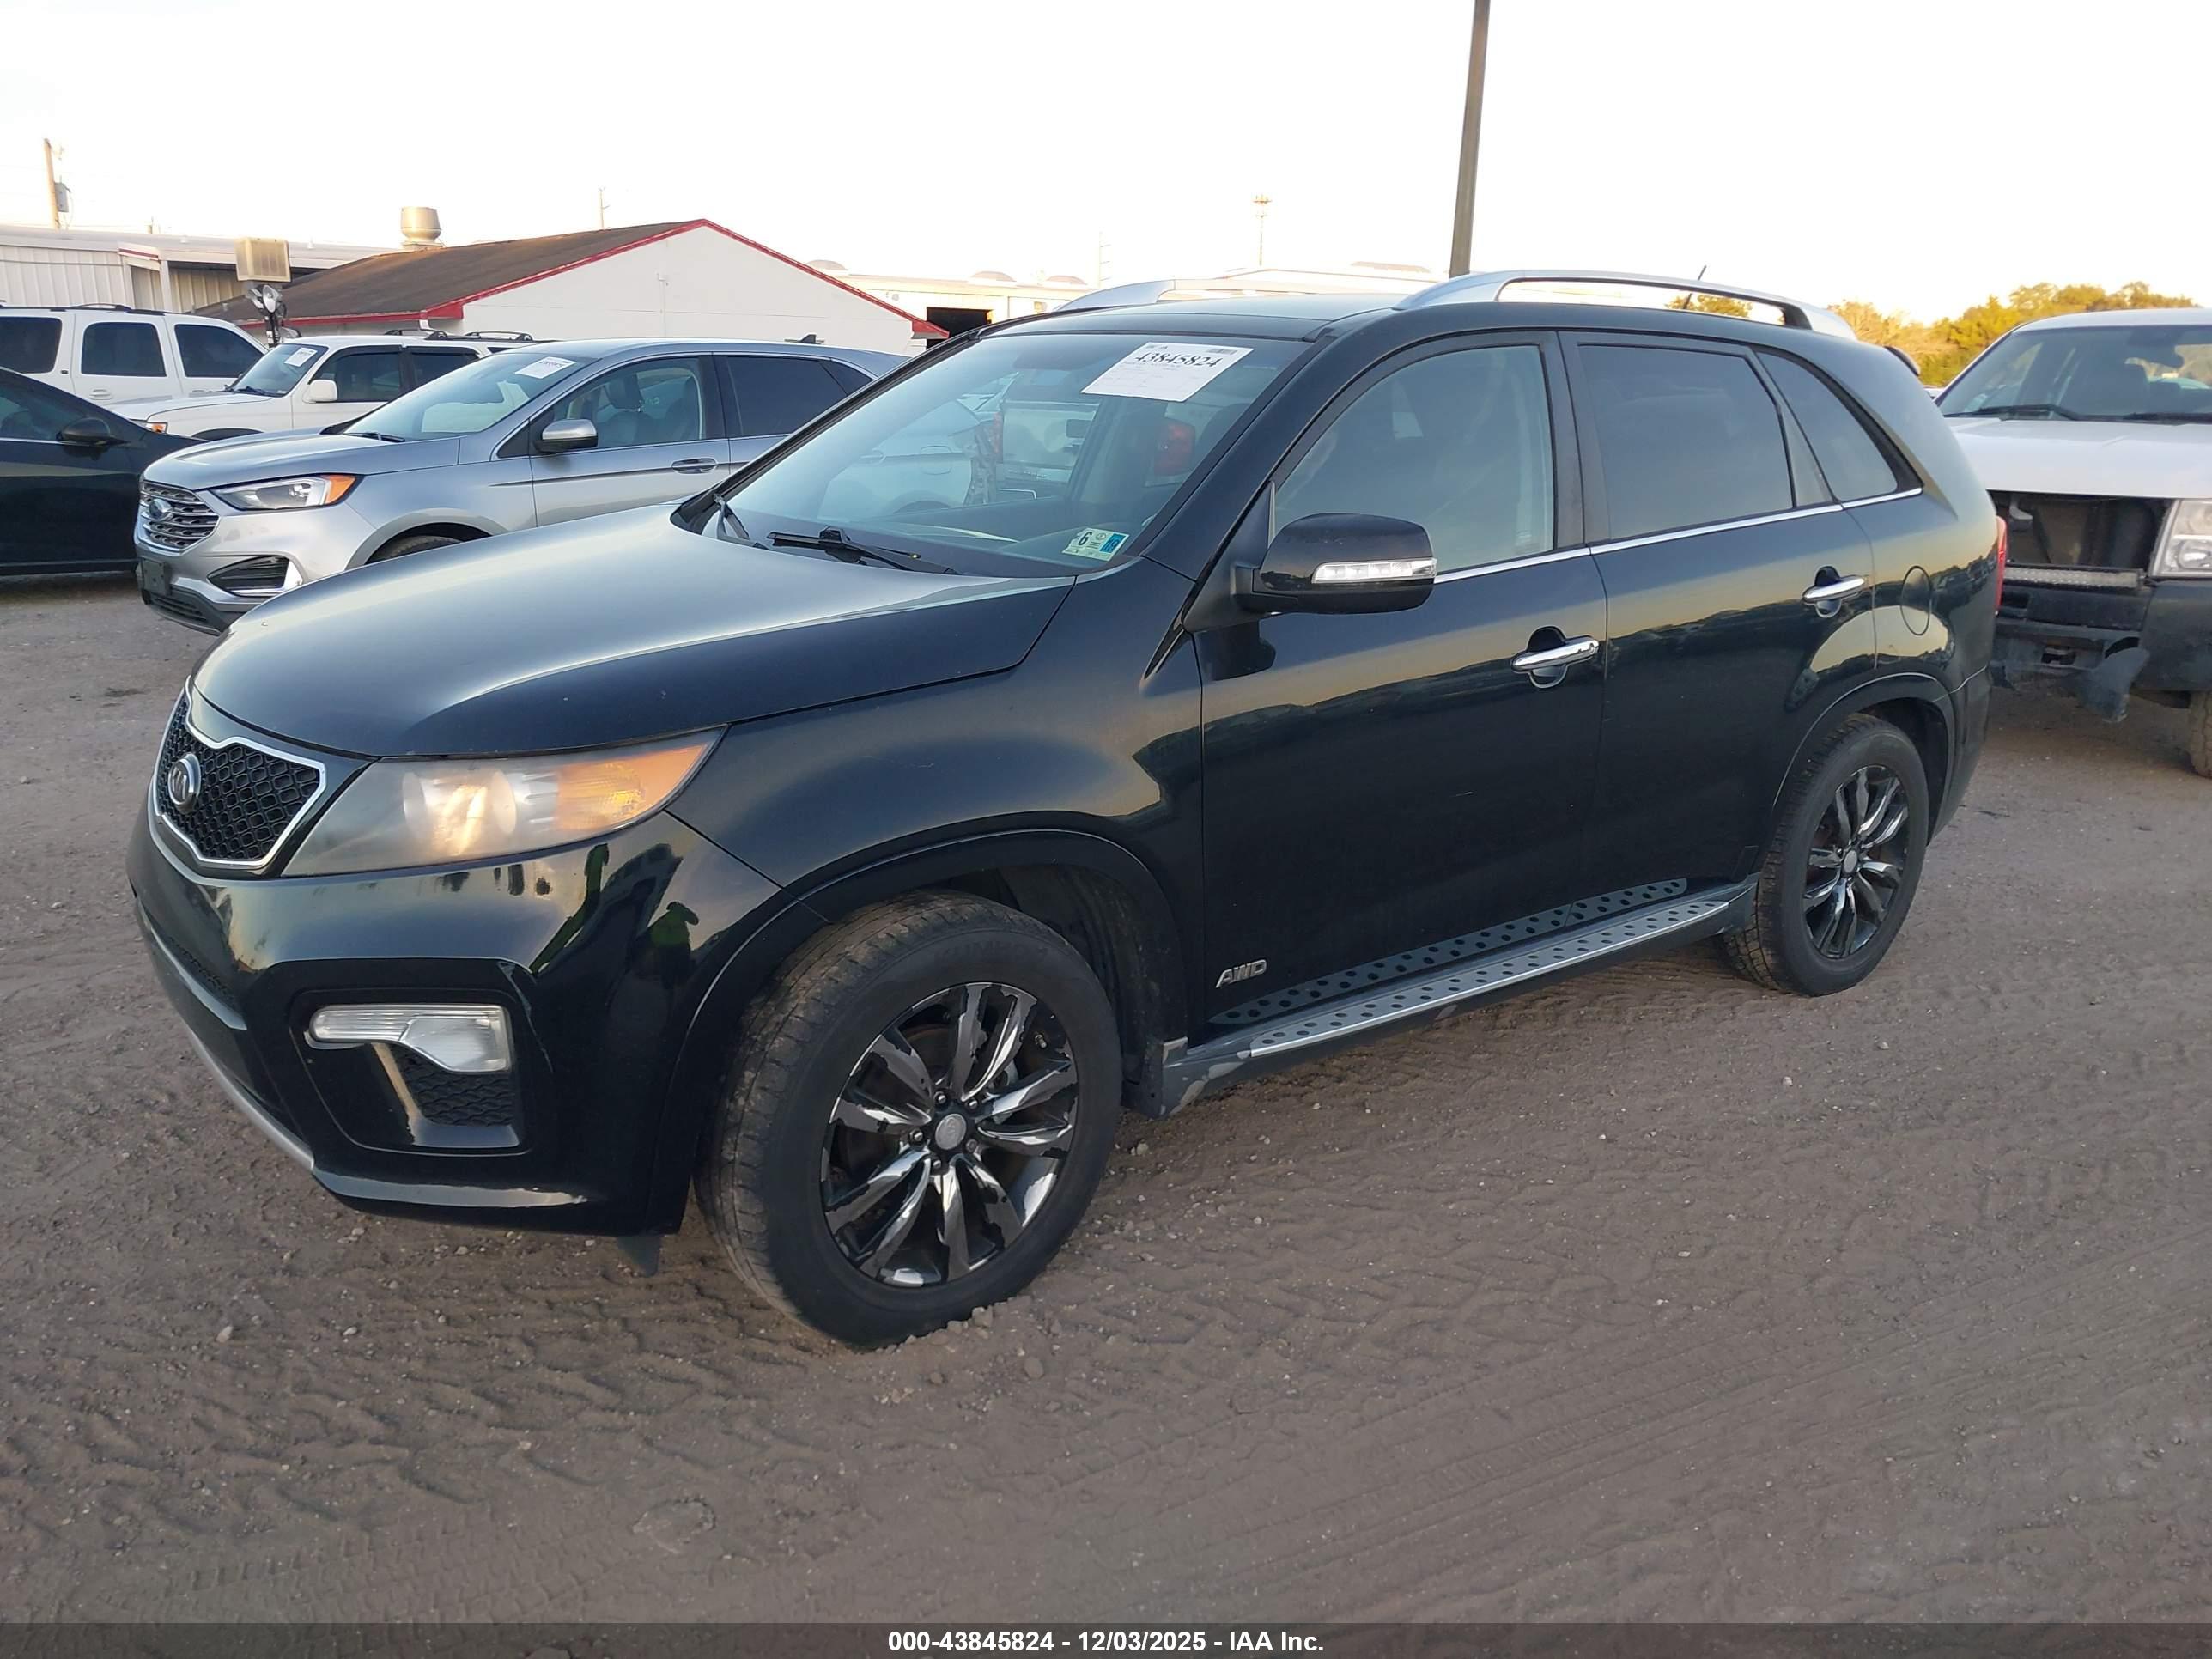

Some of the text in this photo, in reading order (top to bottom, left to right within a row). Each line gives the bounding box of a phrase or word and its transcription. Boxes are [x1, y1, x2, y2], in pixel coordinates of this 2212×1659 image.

[1135, 351, 1224, 368] 43845824
[1078, 531, 1093, 546] 6
[1215, 959, 1267, 988] AWD
